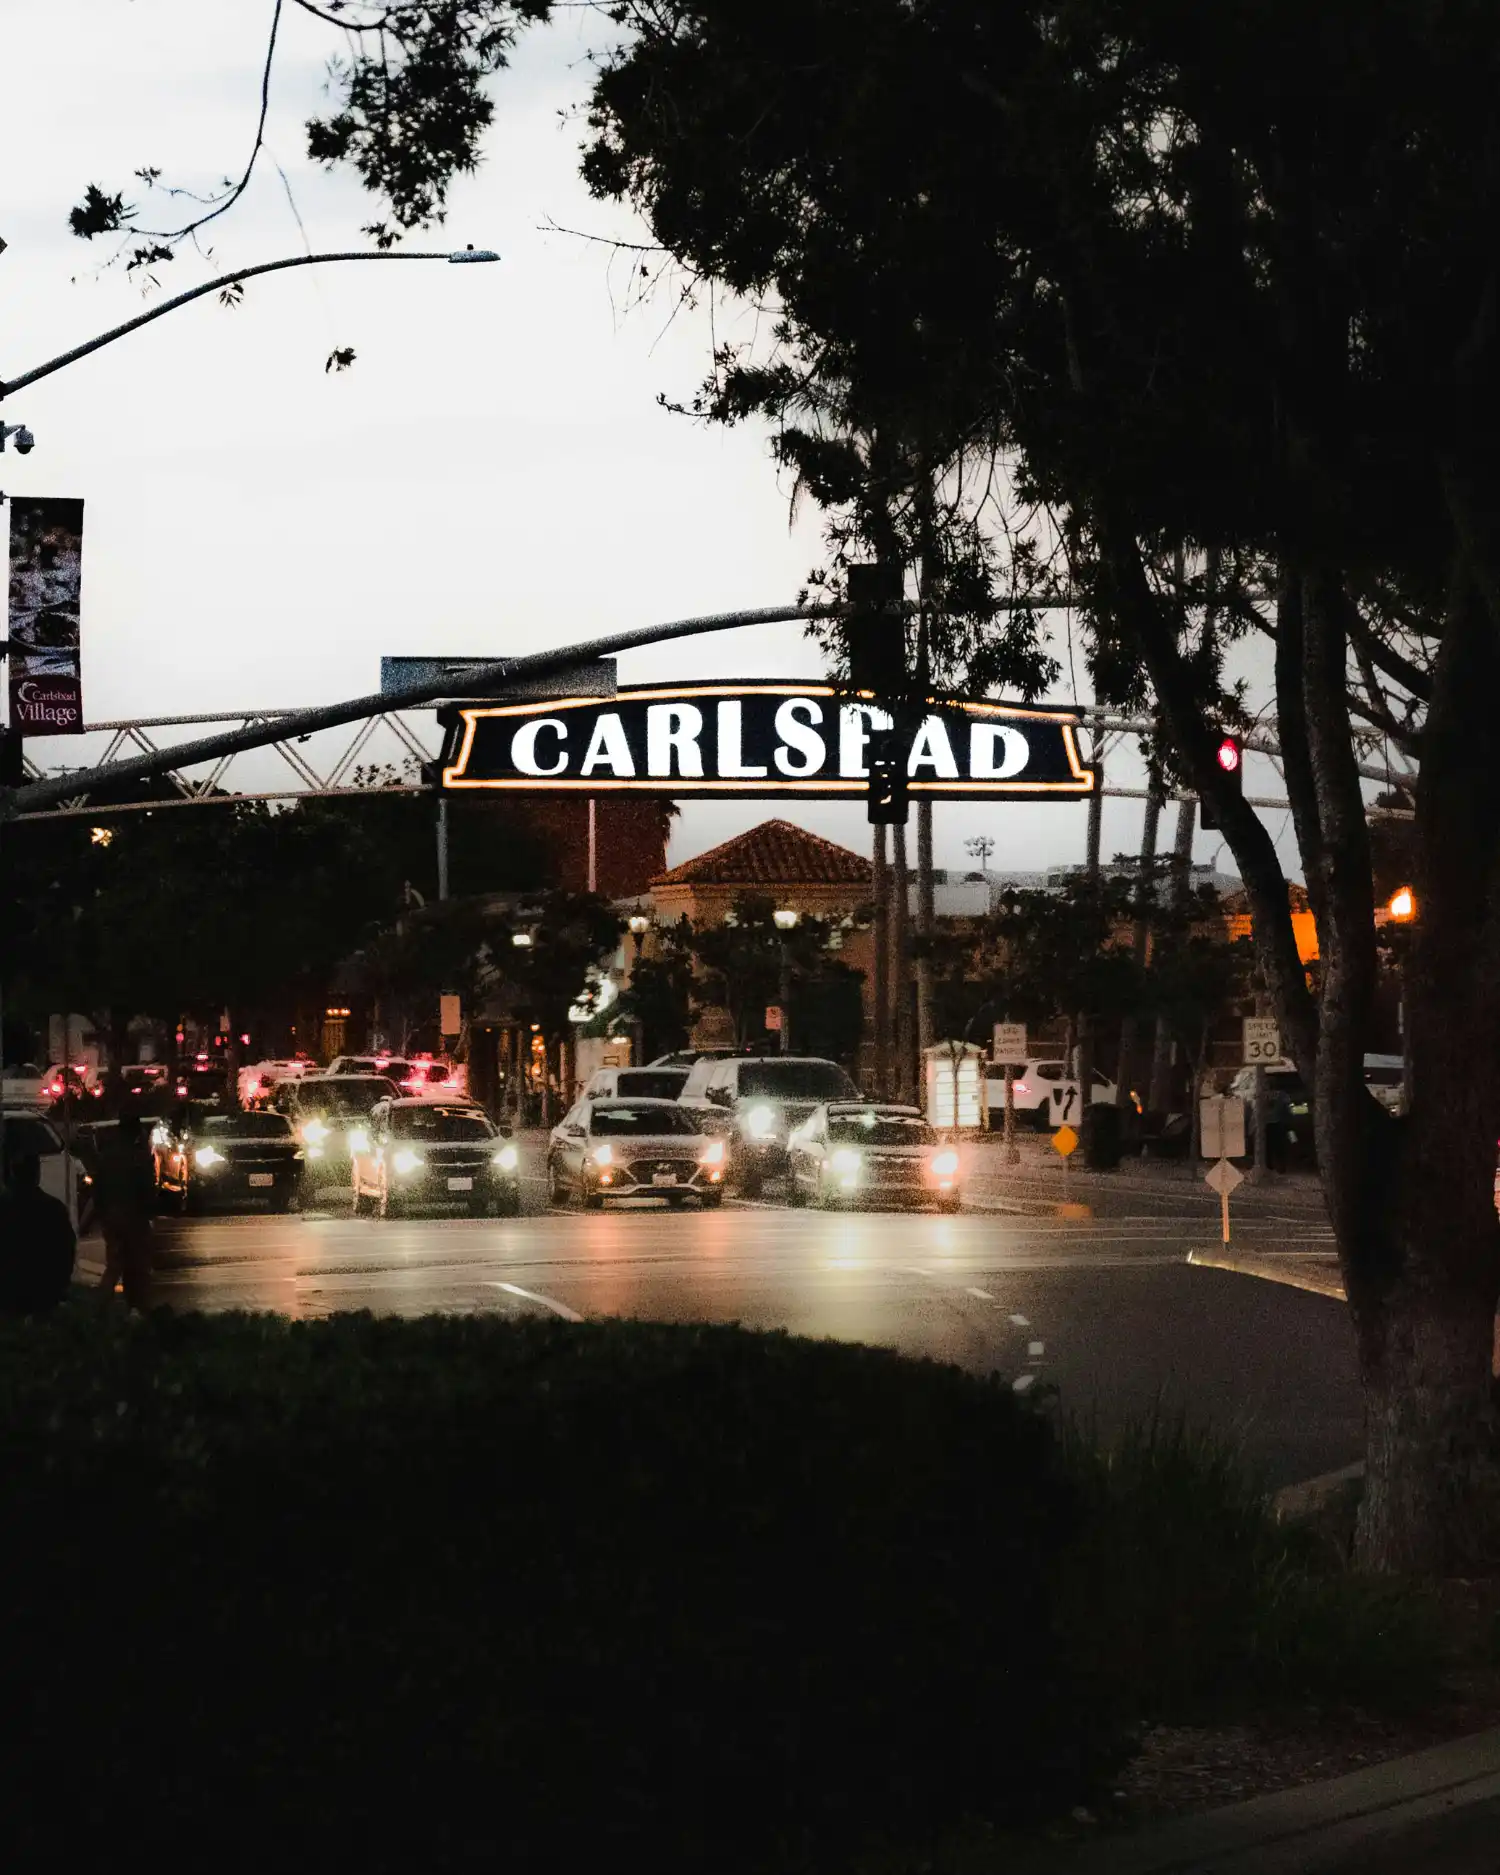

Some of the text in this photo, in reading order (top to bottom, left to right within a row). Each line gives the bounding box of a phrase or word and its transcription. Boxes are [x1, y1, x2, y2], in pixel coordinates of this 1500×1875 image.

[32, 690, 76, 700] Carlsbad
[16, 702, 77, 726] Village
[1249, 1041, 1277, 1058] 30
